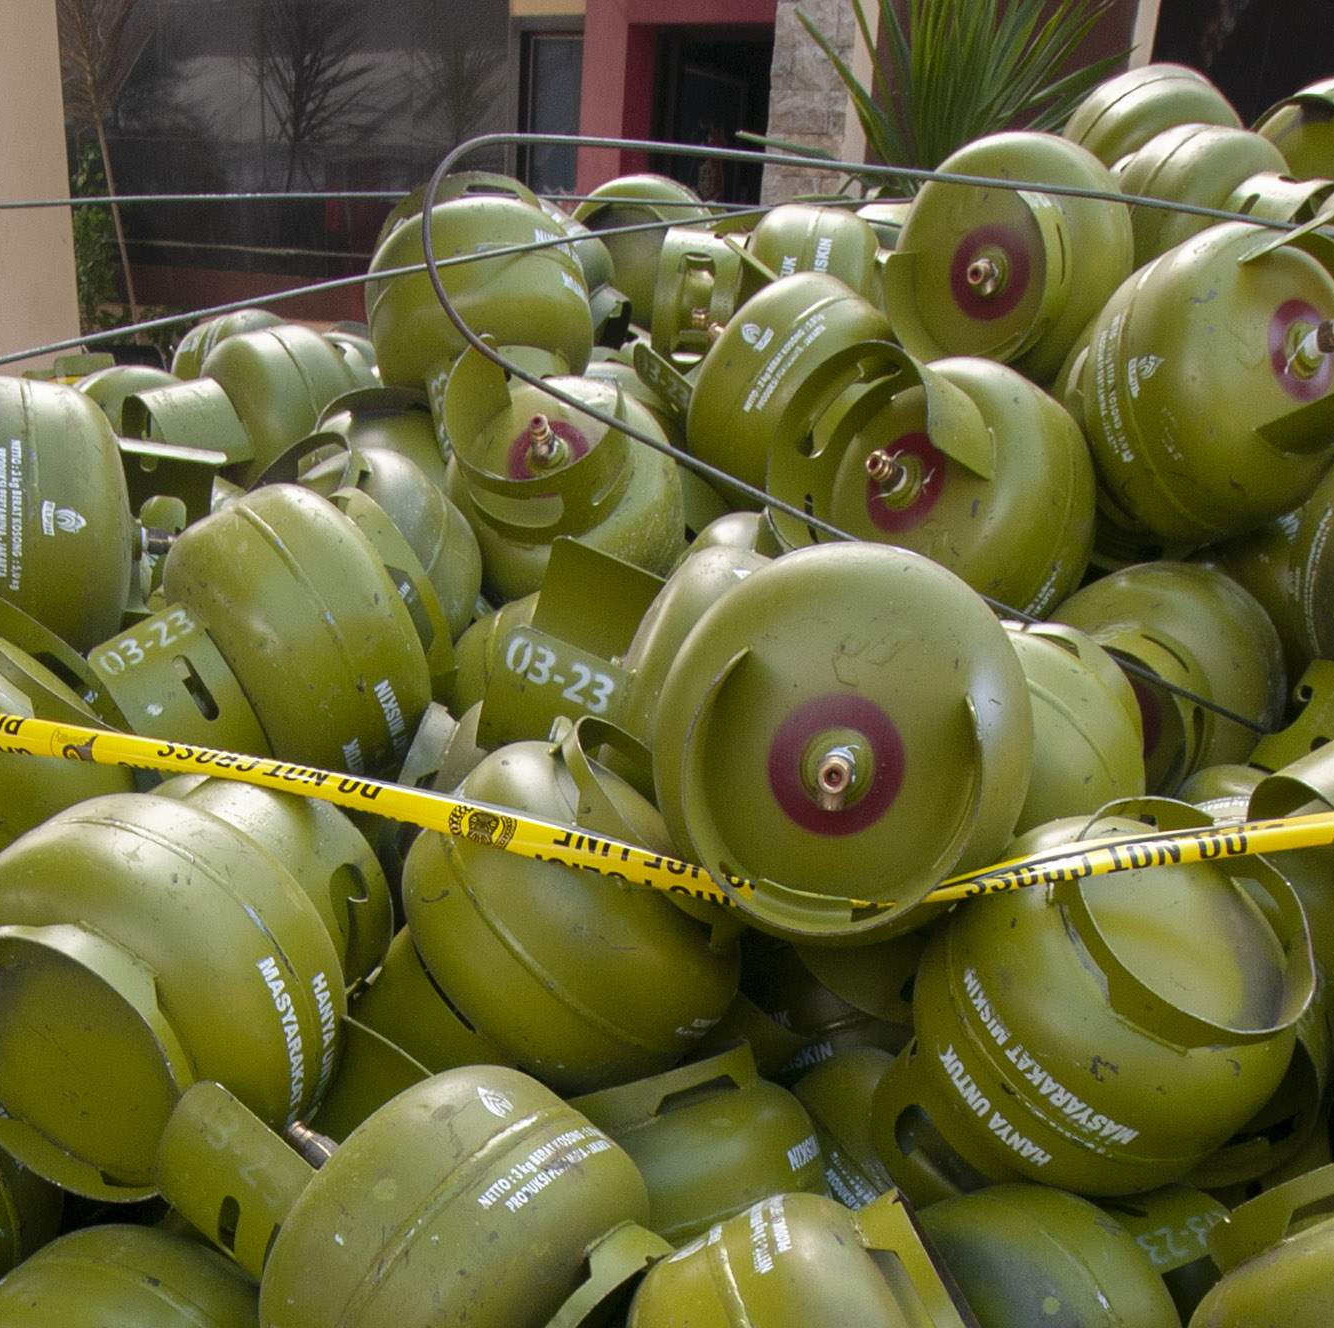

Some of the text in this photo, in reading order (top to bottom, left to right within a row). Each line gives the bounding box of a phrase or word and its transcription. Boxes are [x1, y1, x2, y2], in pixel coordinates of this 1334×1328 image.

[813, 238, 833, 274] ISKIN
[98, 602, 197, 678] 03-23
[504, 632, 616, 715] 03-23
[255, 955, 304, 1107] MASYARAKAT
[310, 971, 335, 1050] HANYA
[963, 966, 1140, 1146] MASYARAKAT MISKIN
[937, 1043, 1054, 1168] HANYA UNTUK
[478, 1176, 512, 1210] NETTO
[504, 1171, 555, 1213] PRODUKSI
